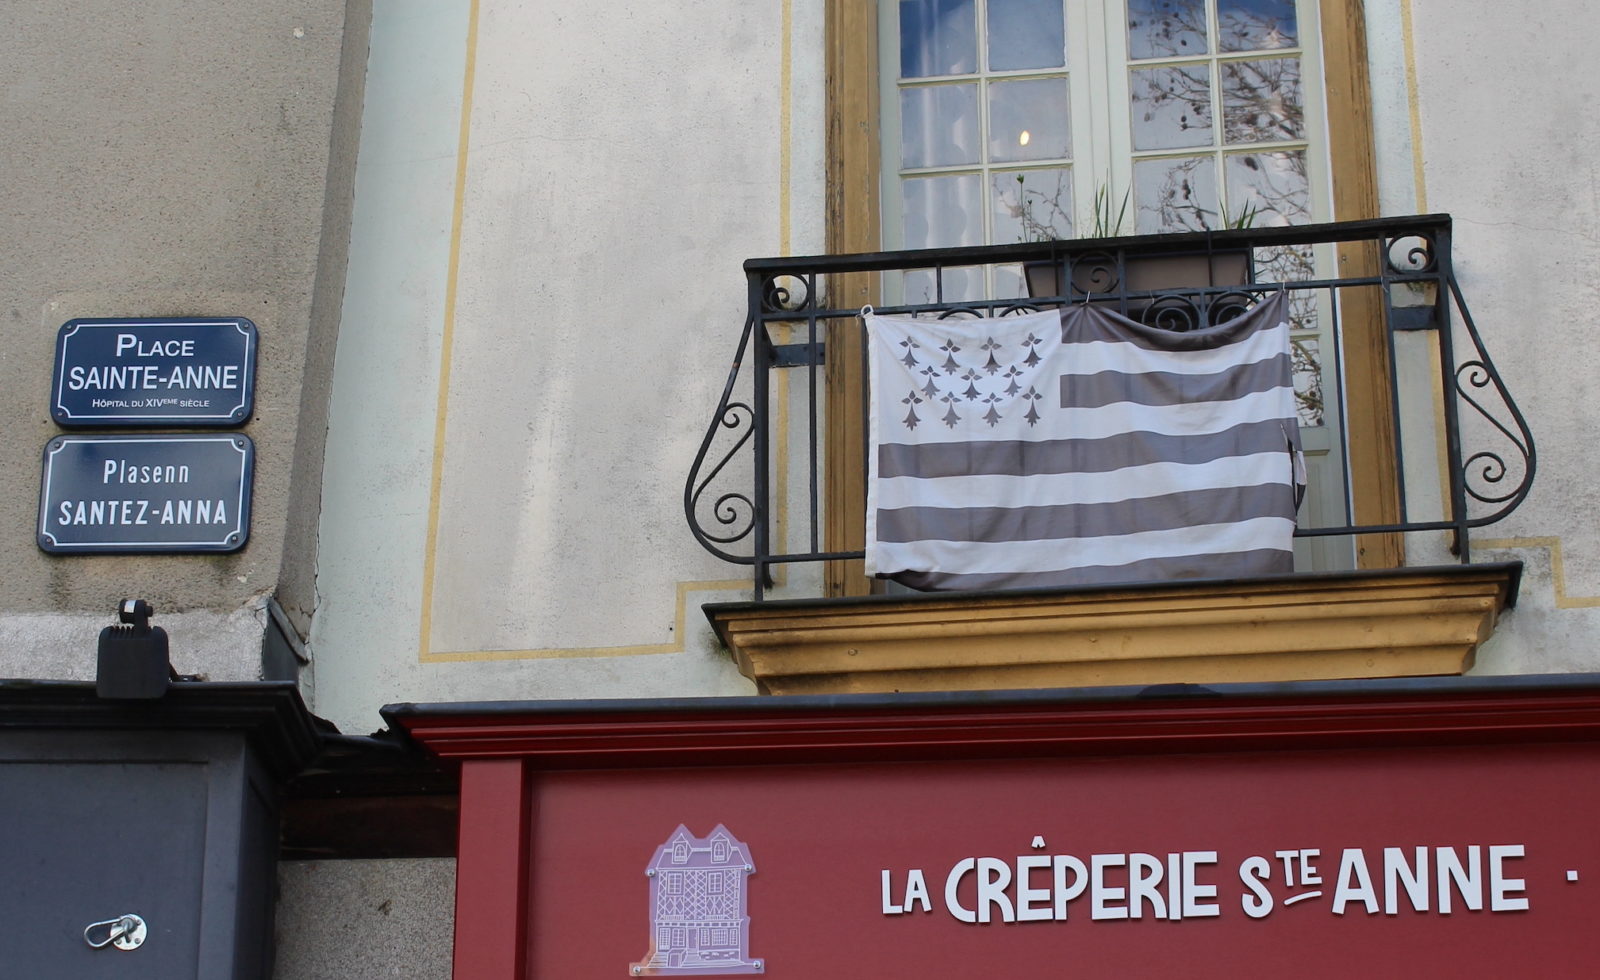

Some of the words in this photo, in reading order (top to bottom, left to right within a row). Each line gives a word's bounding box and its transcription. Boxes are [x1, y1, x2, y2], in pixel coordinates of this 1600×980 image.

[116, 333, 195, 357] PLACE
[68, 365, 238, 391] SAINTE-ANNE
[131, 400, 144, 408] DU
[103, 459, 189, 484] Plasenn
[58, 499, 227, 526] SANTEZ-ANNA
[881, 869, 932, 914] LA
[944, 835, 1221, 923] CRÊPERIE
[1331, 844, 1530, 915] ANNE
